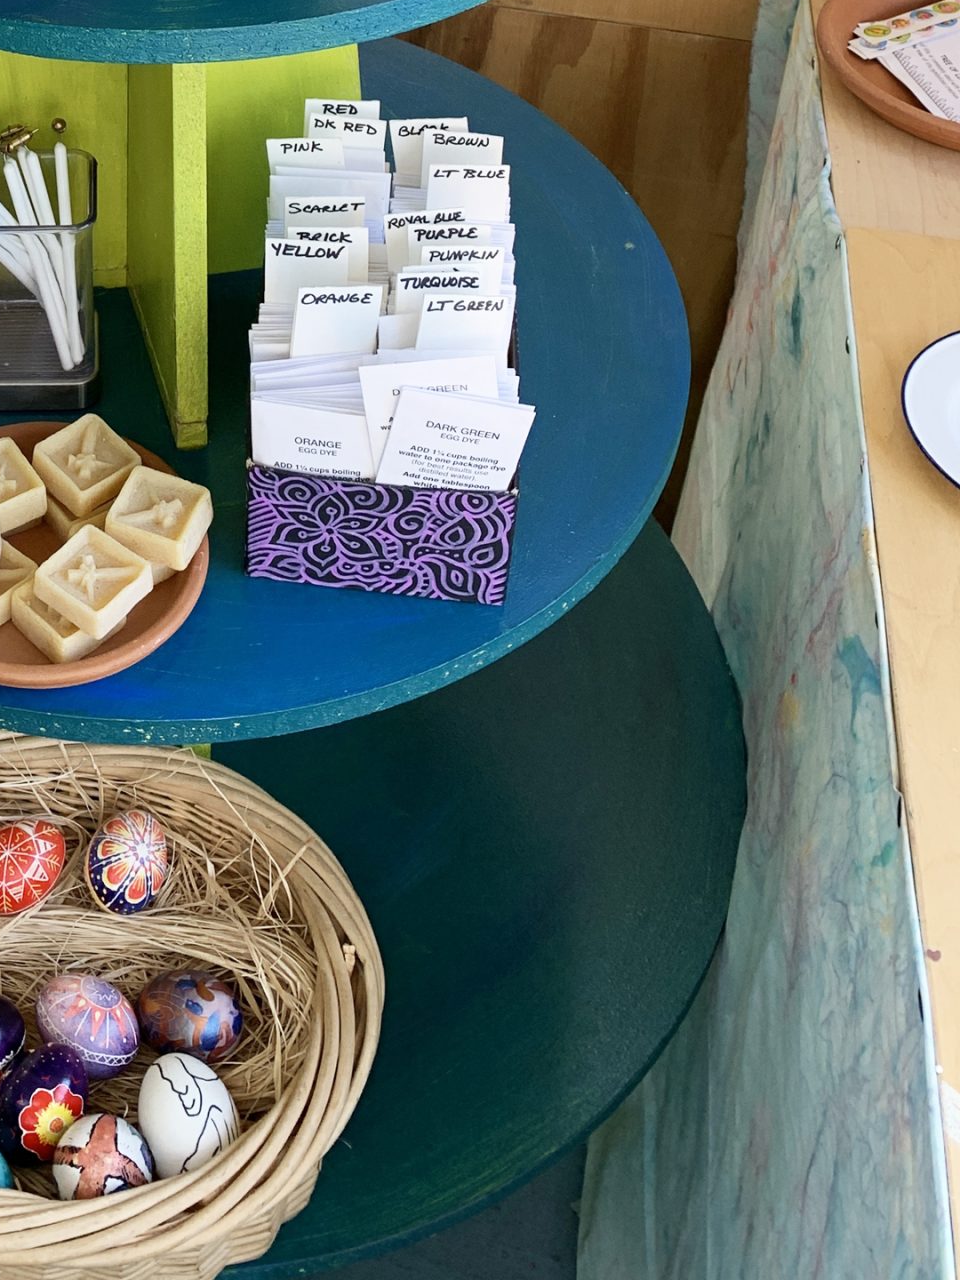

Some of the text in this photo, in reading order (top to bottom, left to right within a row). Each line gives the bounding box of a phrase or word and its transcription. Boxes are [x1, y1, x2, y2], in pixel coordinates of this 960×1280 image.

[322, 103, 358, 115] RED
[314, 118, 377, 135] DK RED
[433, 133, 490, 148] BROWN
[280, 141, 323, 154] PINK
[433, 168, 506, 179] LT BLUE
[288, 202, 365, 215] SCARLET
[388, 211, 466, 229] ROYAL BLUE
[296, 231, 353, 243] BRICK
[414, 227, 478, 241] PURPLE
[271, 243, 345, 259] YELLOW
[429, 249, 499, 262] PUMPKIN
[400, 276, 480, 290] TURQUOISE
[301, 292, 373, 305] ORANGE
[426, 299, 504, 312] LT GREEN
[426, 420, 501, 440] DARK GREEN
[294, 436, 342, 449] ORANGE
[440, 433, 480, 445] EGG DYE
[298, 446, 337, 457] EGG DYE
[410, 445, 499, 465] ADD cups boiling
[398, 450, 422, 460] water
[452, 459, 489, 470] package
[490, 463, 506, 472] dye
[274, 461, 293, 469] ADD
[309, 466, 330, 475] cups
[332, 468, 361, 477] boiling
[402, 471, 421, 480] Add
[422, 475, 439, 483] one
[442, 477, 490, 490] tablespoon
[414, 480, 438, 489] white
